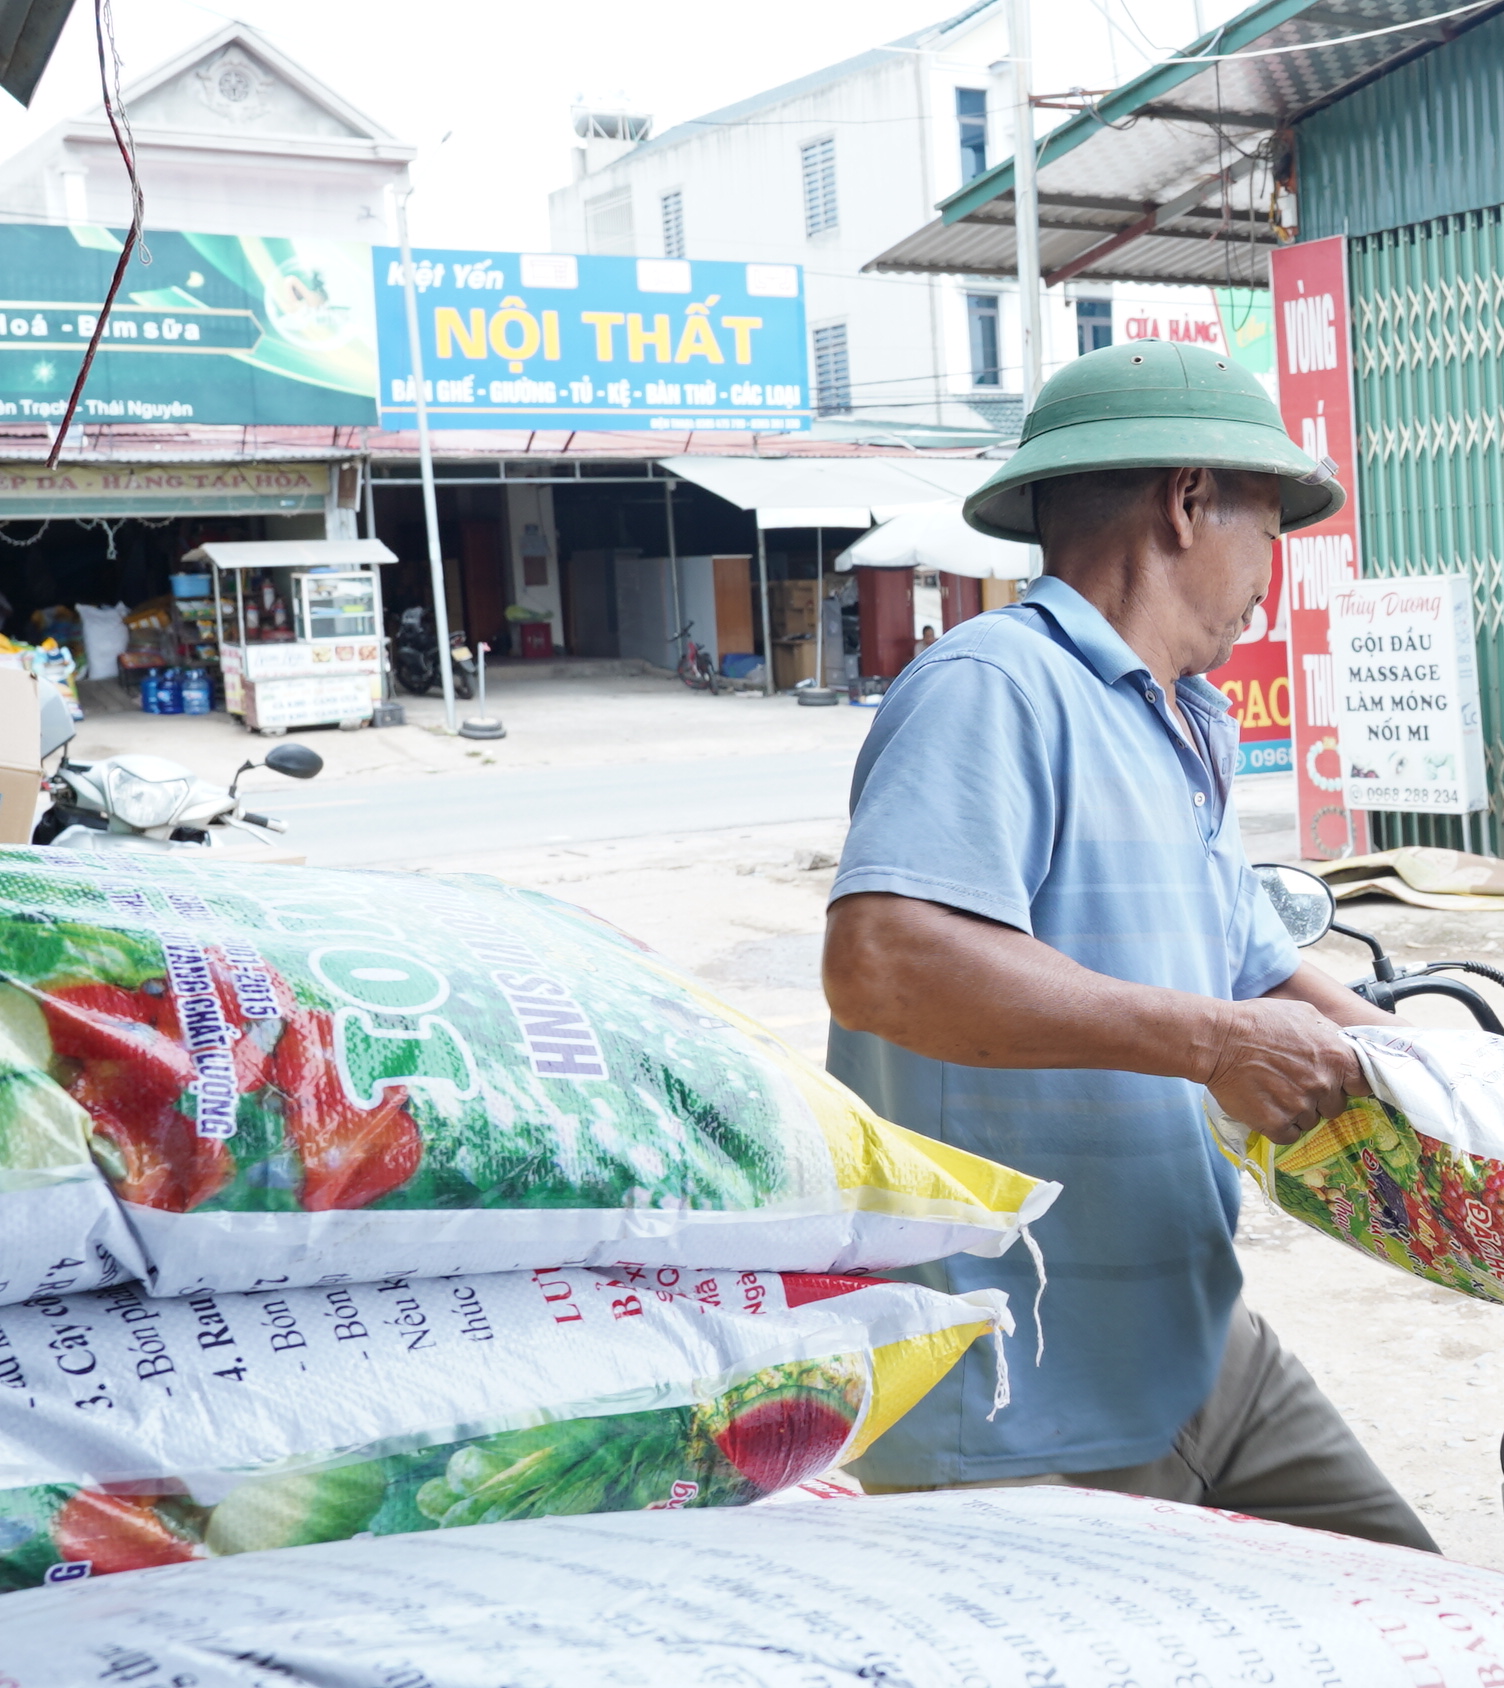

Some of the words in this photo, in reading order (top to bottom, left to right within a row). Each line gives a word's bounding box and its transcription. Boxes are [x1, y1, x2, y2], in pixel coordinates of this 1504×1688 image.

[453, 258, 504, 291] Yến
[143, 317, 201, 341] sữa
[433, 296, 561, 373] NỘI
[581, 294, 763, 364] THẤT
[1169, 313, 1219, 343] HÀNG
[1284, 280, 1338, 374] VÒNG
[85, 399, 124, 416] Thái
[127, 400, 194, 419] Nguyên
[436, 374, 475, 402] GHẾ
[569, 374, 593, 404] TỦ
[607, 378, 631, 407] KỆ
[1381, 591, 1441, 621] Dương
[1351, 632, 1383, 658] GỘI
[1349, 664, 1440, 683] MASSAGE
[1346, 691, 1384, 712] LÀM
[1390, 690, 1448, 711] MÓNG
[1367, 717, 1401, 741] NỐI
[1408, 724, 1430, 741] MI
[1404, 787, 1429, 803] 288
[1434, 788, 1459, 804] 234
[183, 998, 240, 1049] CHẤT
[495, 970, 608, 1079] SINH
[191, 1052, 237, 1136] LƯỢNG
[188, 1296, 237, 1351] Rau
[261, 1299, 308, 1353] Bón
[323, 1288, 370, 1343] Bón
[395, 1293, 437, 1353] Nếu
[452, 1285, 495, 1342] thúc
[48, 1322, 97, 1376] Cây
[127, 1325, 177, 1381] Bón
[212, 1356, 248, 1382] 4.
